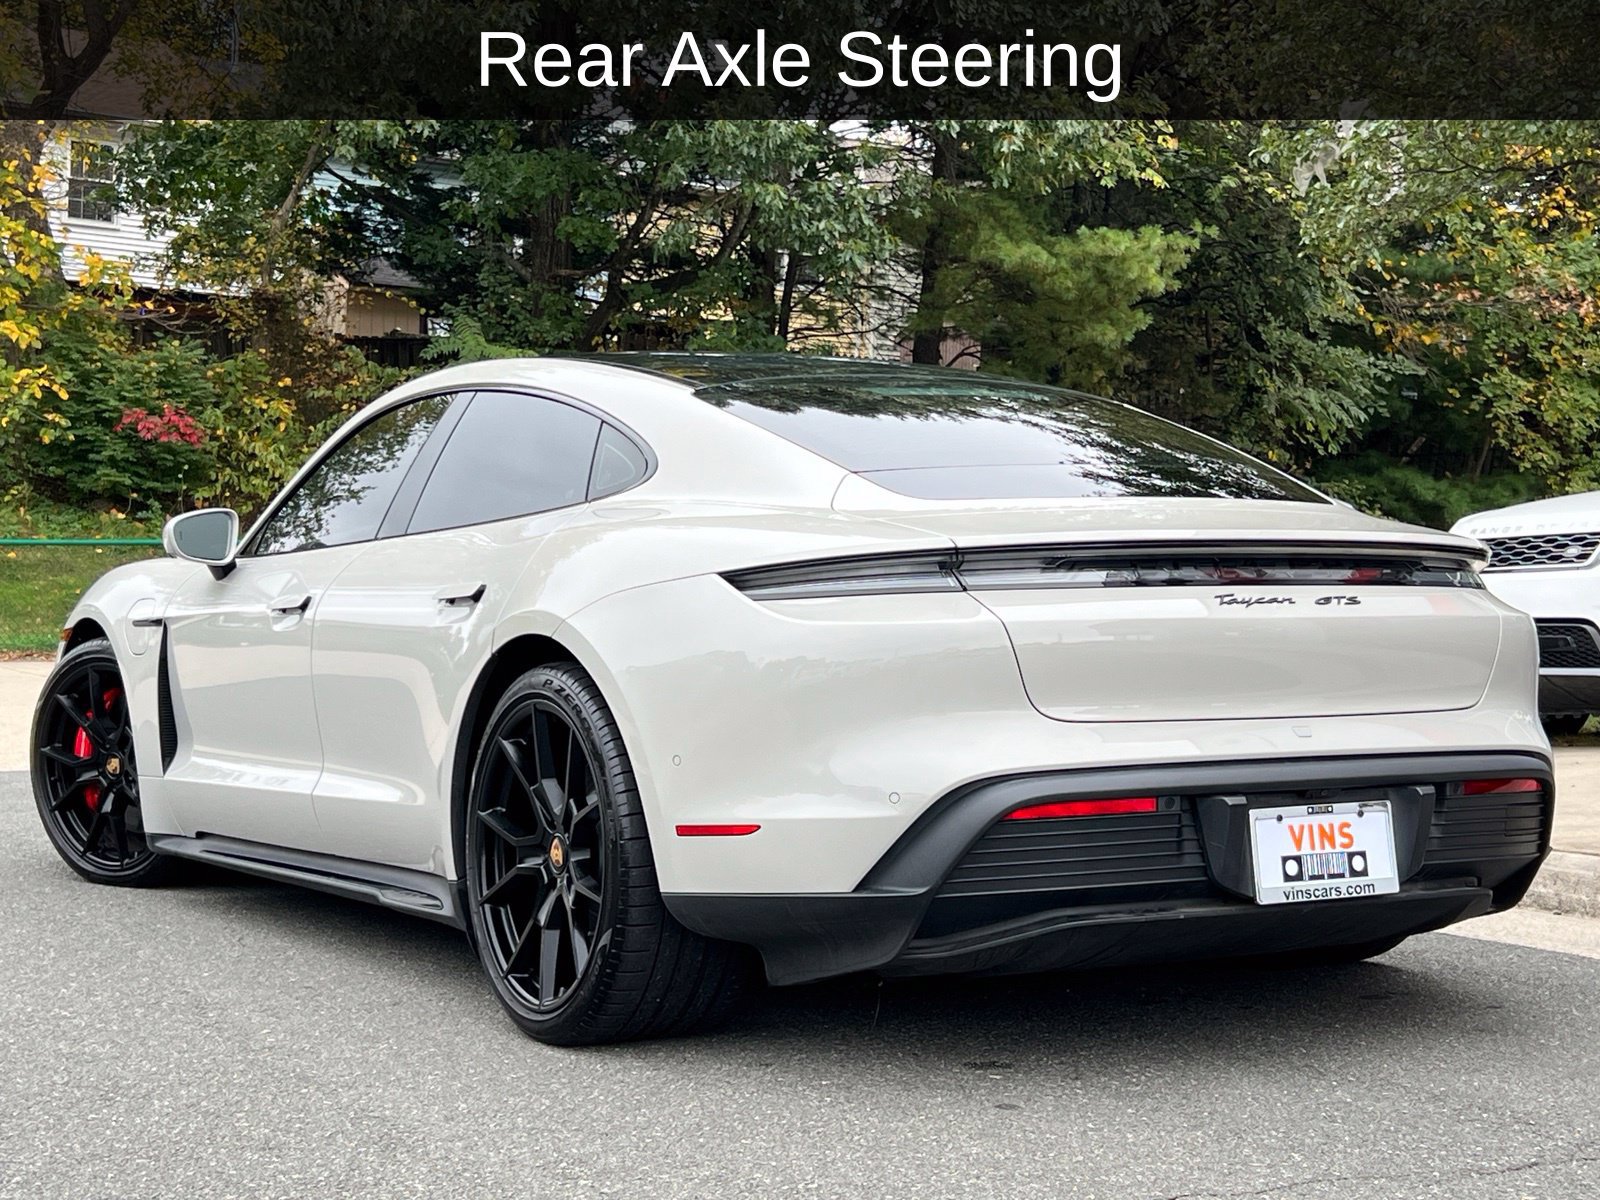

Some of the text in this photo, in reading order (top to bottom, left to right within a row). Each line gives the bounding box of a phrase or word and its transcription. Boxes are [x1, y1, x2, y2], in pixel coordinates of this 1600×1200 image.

[1214, 592, 1362, 608] Taycan GTS
[1288, 821, 1354, 851] VINS
[1283, 883, 1376, 901] vinscars.com
